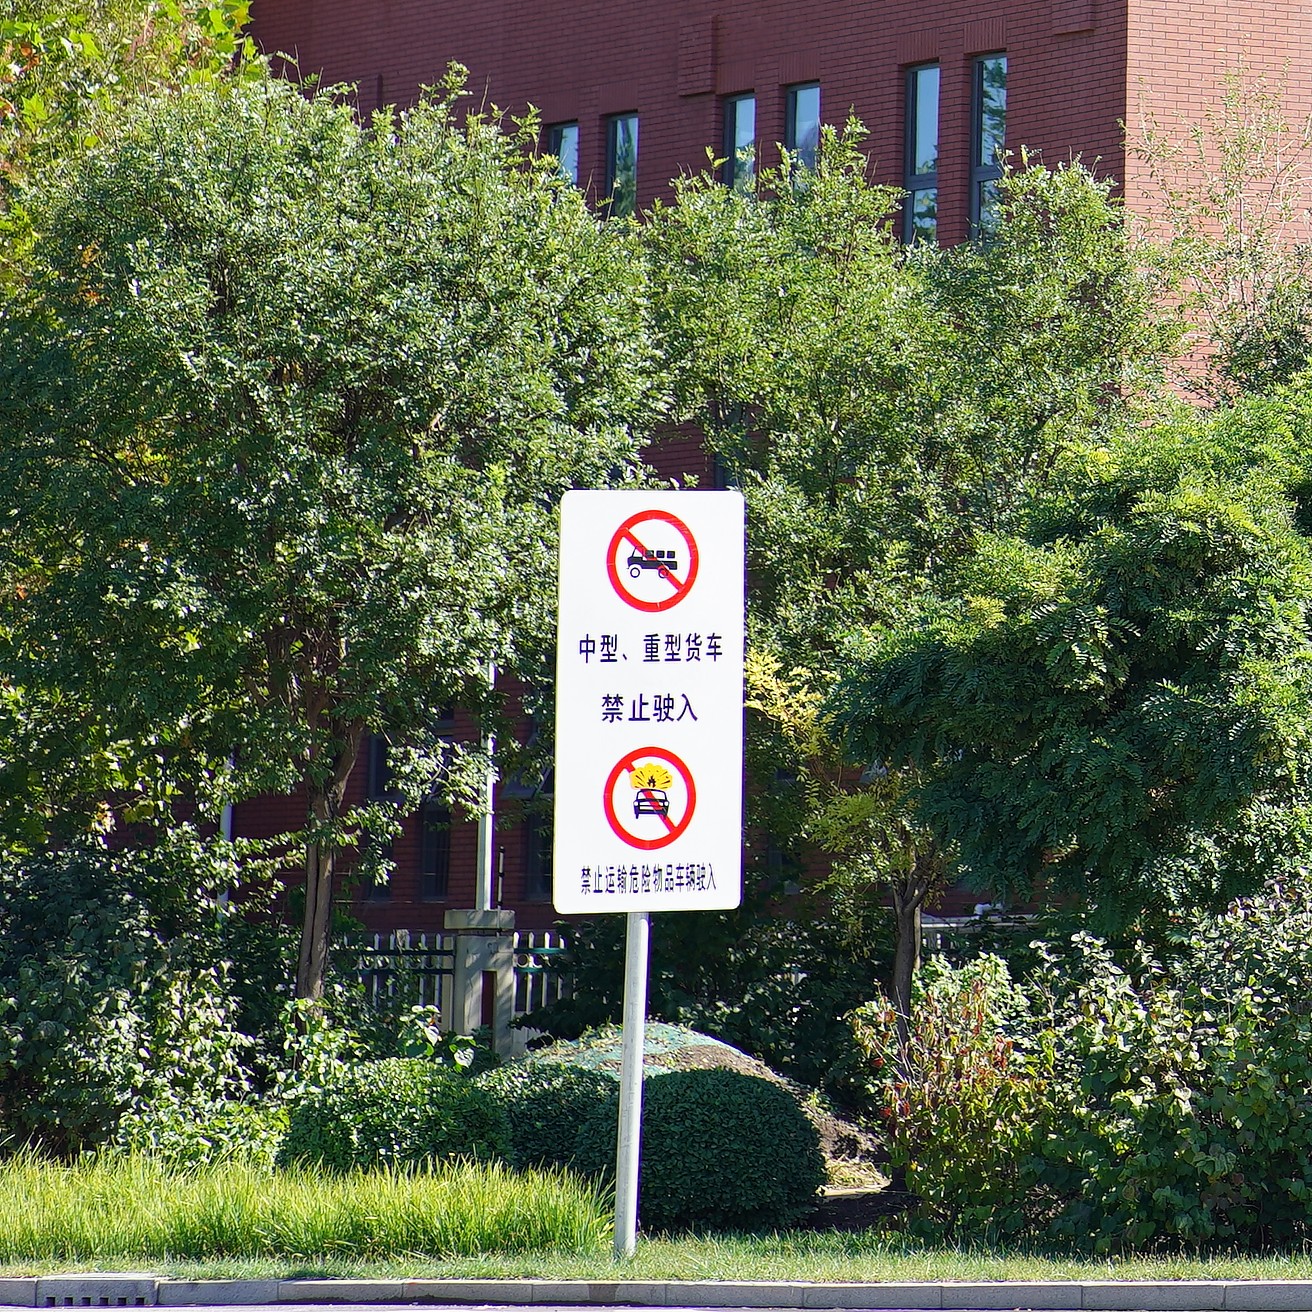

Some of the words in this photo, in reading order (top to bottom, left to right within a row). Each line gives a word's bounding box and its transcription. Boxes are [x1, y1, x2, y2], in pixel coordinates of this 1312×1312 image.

[579, 632, 723, 664] 中型、重型货车
[601, 693, 698, 723] 禁止驶入
[581, 862, 717, 895] 禁止运输危险物品车辆驶入
